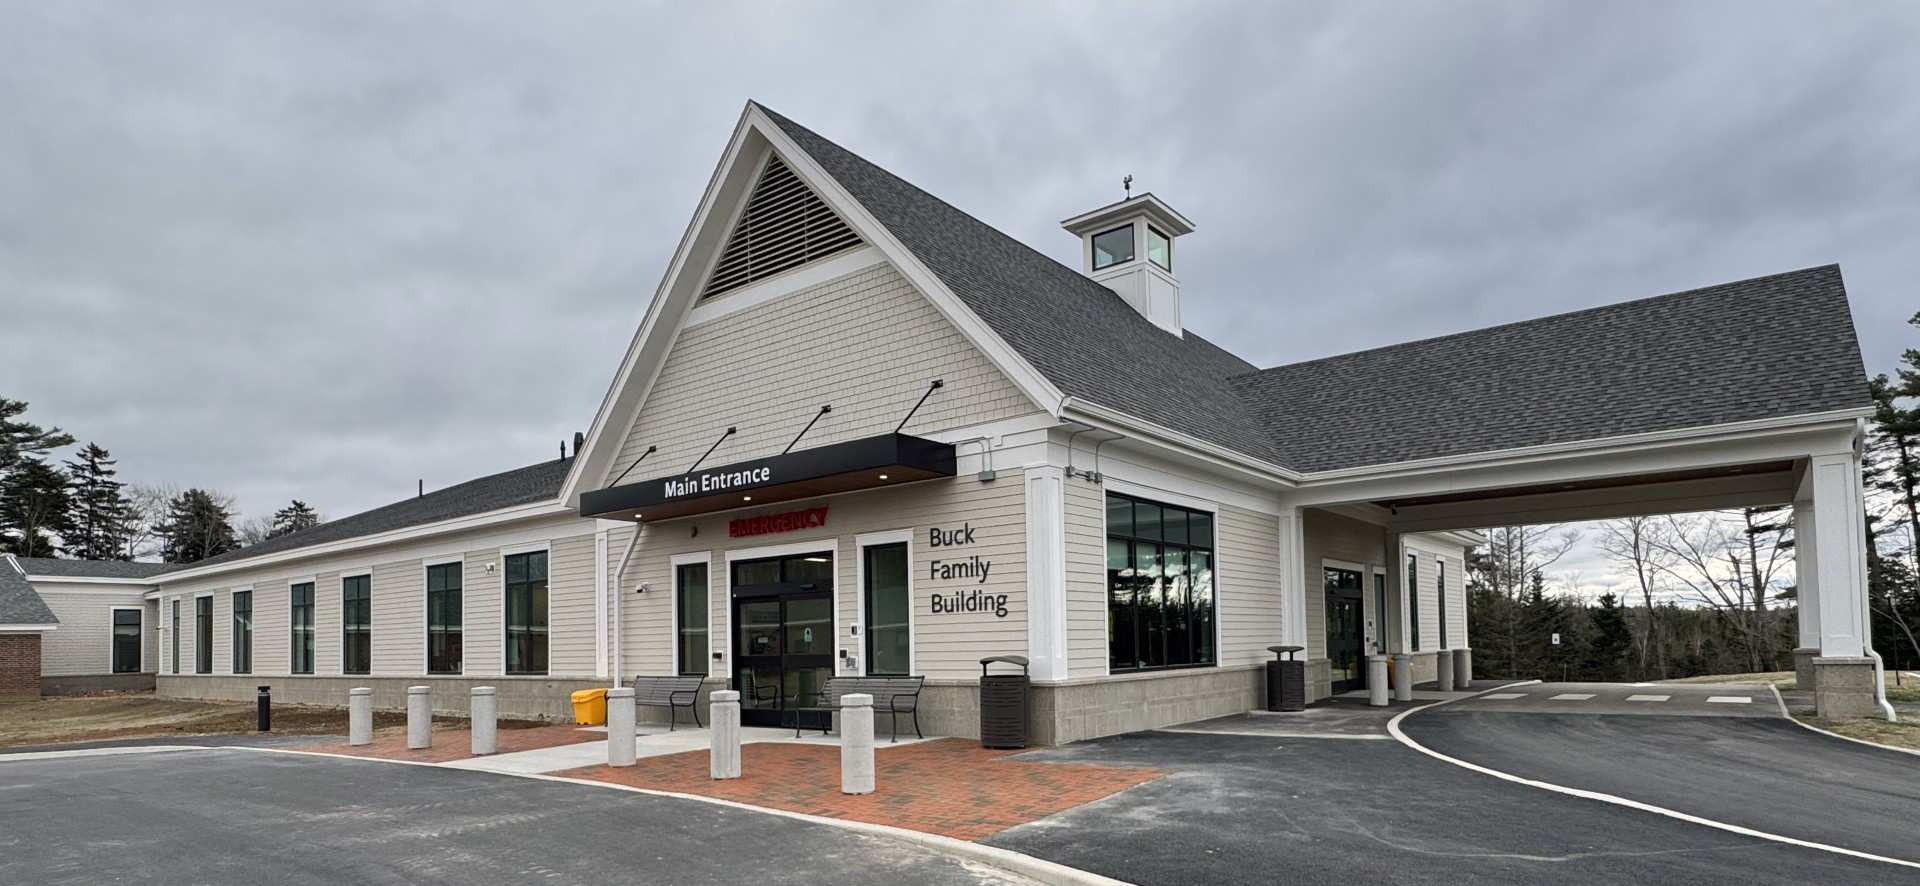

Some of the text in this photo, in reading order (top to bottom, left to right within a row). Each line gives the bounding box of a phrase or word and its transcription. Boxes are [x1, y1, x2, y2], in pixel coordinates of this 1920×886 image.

[664, 467, 770, 498] Main Entrance
[729, 507, 828, 538] EMERGENCY
[930, 522, 975, 547] Buck
[931, 555, 990, 583] Family
[932, 590, 1008, 617] Building
